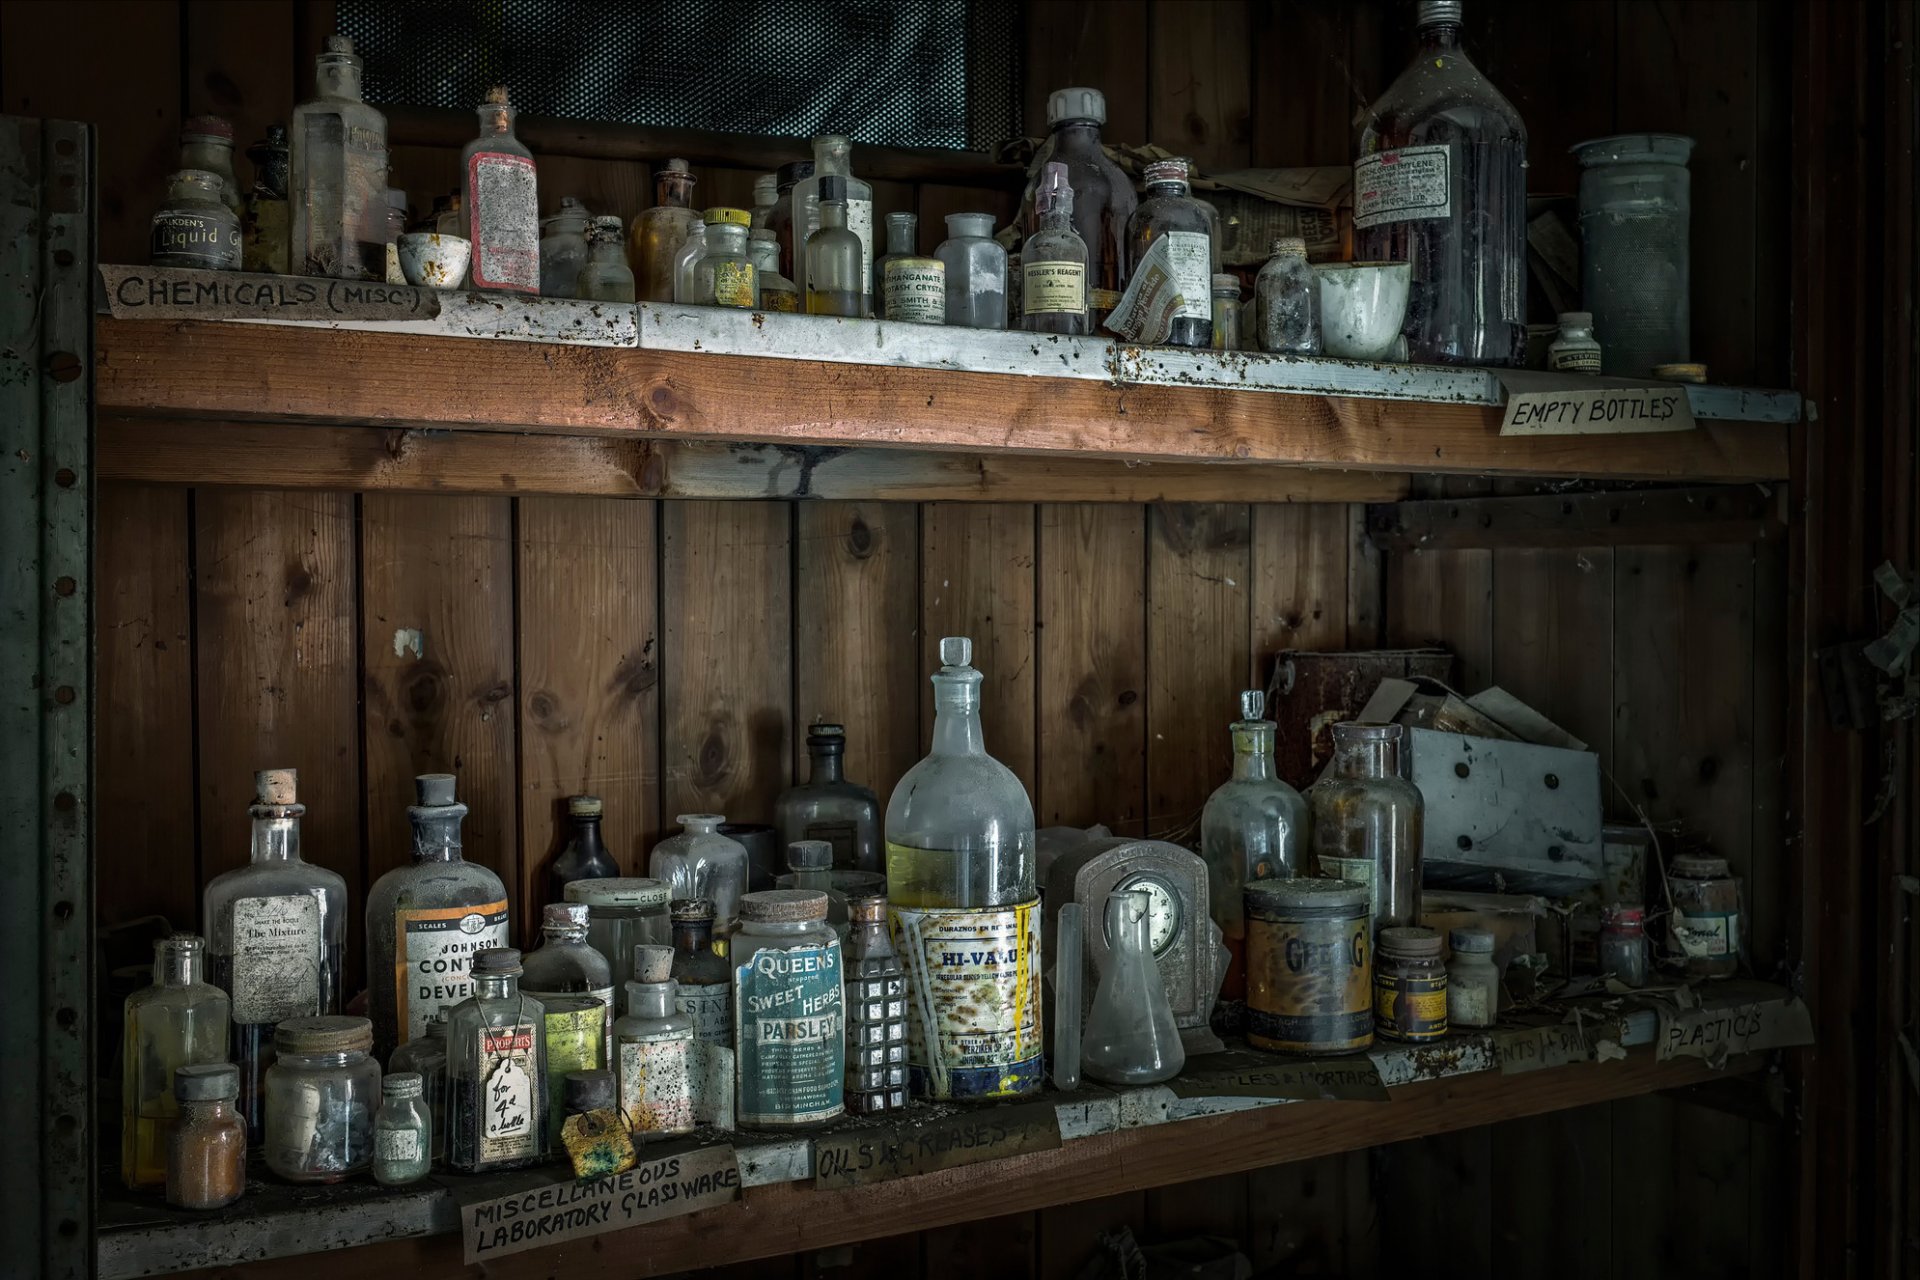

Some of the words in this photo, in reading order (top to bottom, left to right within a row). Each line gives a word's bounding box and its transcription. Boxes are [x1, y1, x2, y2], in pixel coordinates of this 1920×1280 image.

[161, 227, 218, 249] Liquid
[1299, 209, 1317, 243] BEECH
[116, 276, 318, 307] CHEMICALS
[900, 296, 929, 304] SMITH
[1120, 291, 1145, 334] Solution
[1125, 308, 1145, 342] ydrogen
[1511, 401, 1585, 425] EMPTY
[1589, 396, 1679, 422] BOTTLES
[246, 928, 266, 938] The
[269, 927, 307, 937] Mixture
[418, 922, 447, 930] SCALES
[441, 938, 498, 954] JOHNSON
[942, 949, 1019, 966] HI-VALU
[419, 957, 475, 974] CONT
[419, 982, 475, 1000] DEVEL
[748, 984, 804, 1013] SWEET
[803, 984, 840, 1016] HERBS
[763, 1016, 836, 1040] PARSLEY
[1669, 1010, 1762, 1051] PLASTICS
[492, 1075, 512, 1102] for
[490, 1123, 497, 1132] a
[498, 1114, 525, 1131] bottle
[819, 1143, 873, 1178] OILS
[474, 1158, 680, 1228] MISCELLANEOUS
[476, 1200, 612, 1253] LABORATORY
[621, 1167, 739, 1219] GLASSWARE
